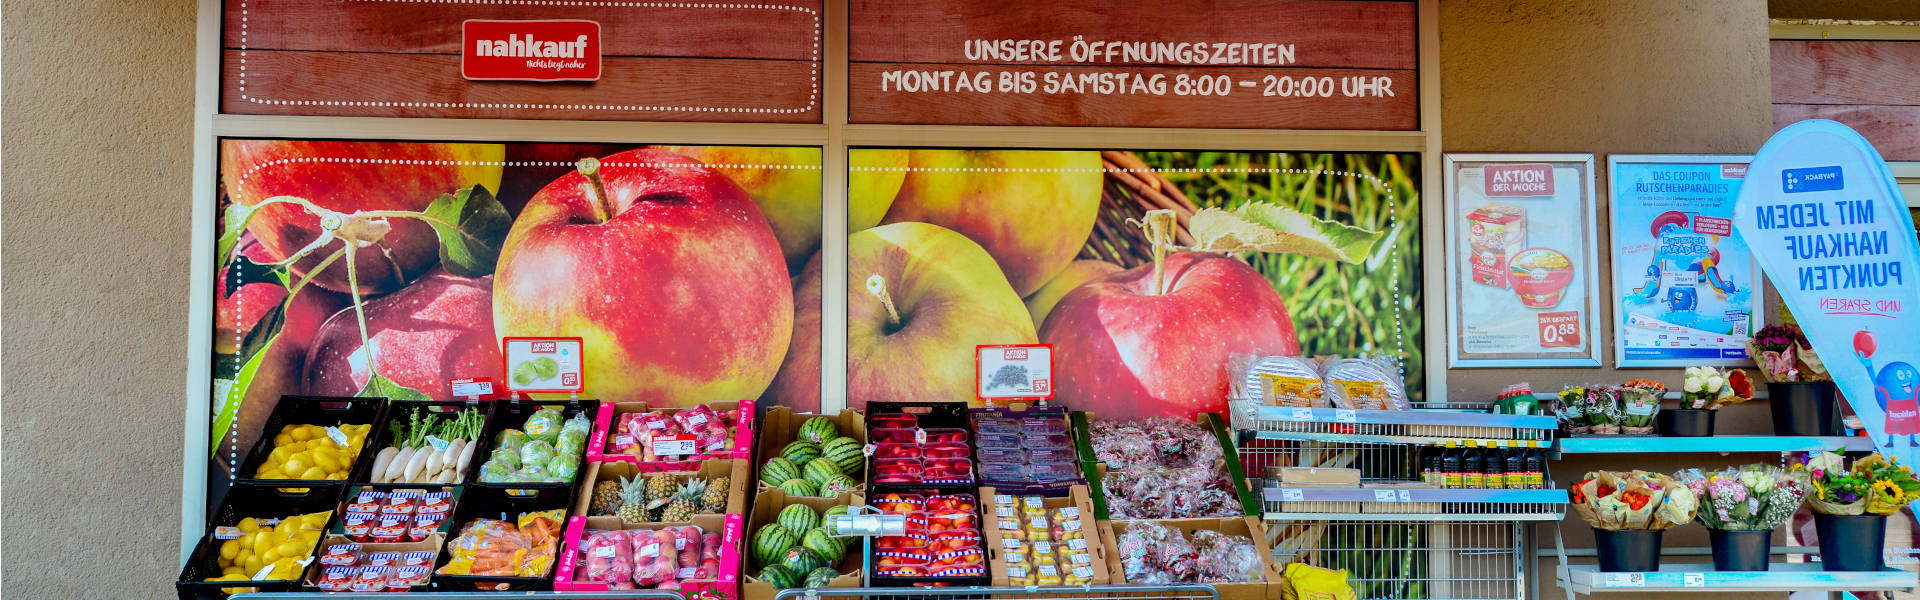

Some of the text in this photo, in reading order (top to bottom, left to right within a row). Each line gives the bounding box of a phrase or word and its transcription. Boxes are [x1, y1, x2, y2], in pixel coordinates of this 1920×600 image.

[476, 33, 588, 59] nahkauf
[964, 35, 1295, 65] UNSERE ÖFFNUNGSZEITEN
[881, 70, 993, 94] MONTAG
[998, 71, 1037, 94] BIS
[1043, 71, 1167, 95] SAMSTAG
[1174, 74, 1232, 96] 8:00
[1263, 75, 1335, 98] 20:00
[1341, 76, 1396, 98] UHR
[1493, 169, 1545, 183] AKTION
[1653, 171, 1711, 181] DAS COUPON
[1493, 182, 1547, 192] DER WOCHE
[1636, 182, 1729, 194] RUTSCHENPARADIES
[1662, 236, 1706, 245] RUTSCHEN
[1660, 244, 1711, 256] PARADIES
[1543, 323, 1576, 343] 0.88
